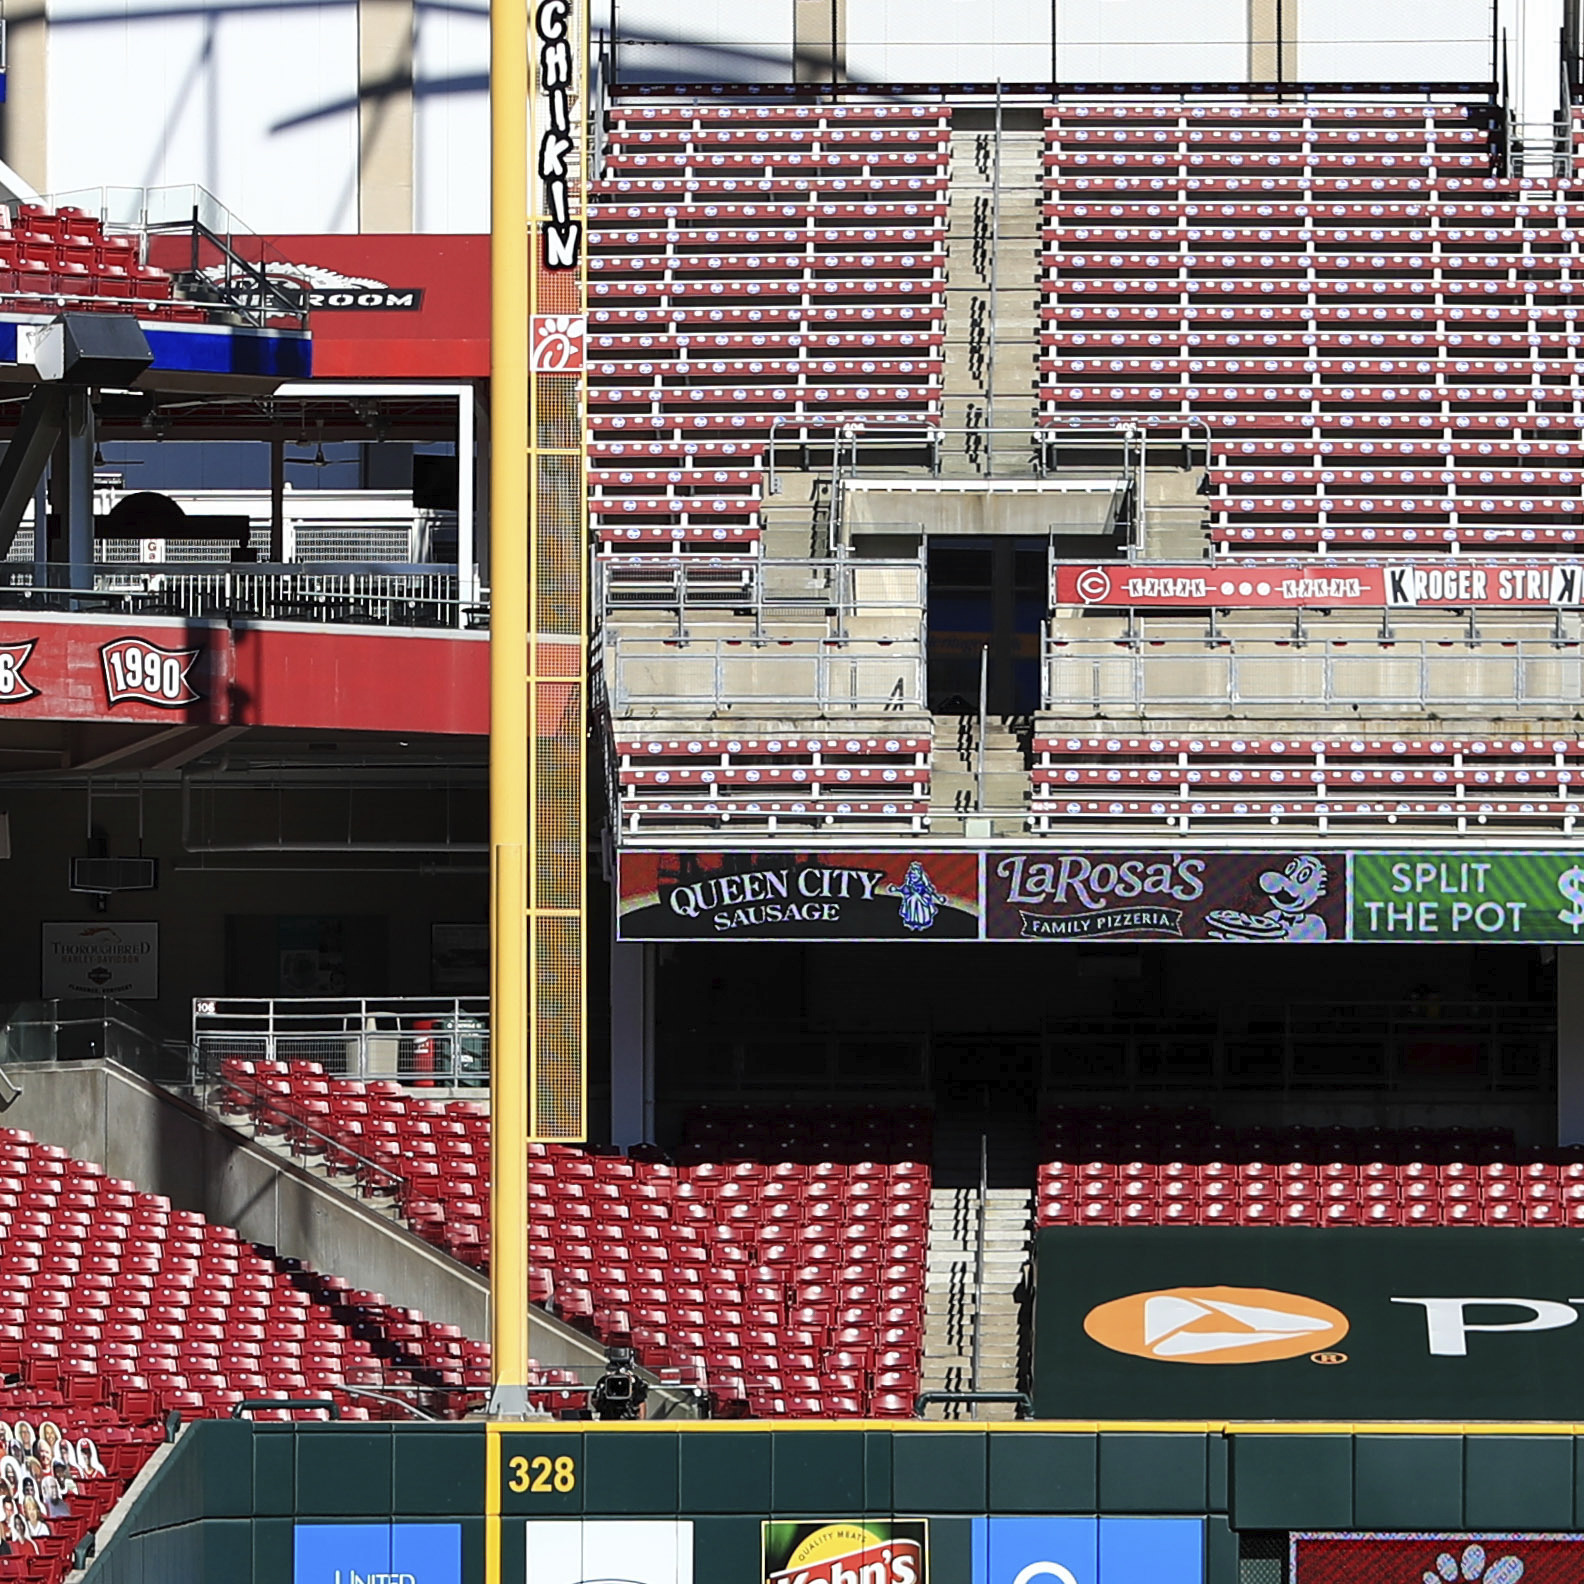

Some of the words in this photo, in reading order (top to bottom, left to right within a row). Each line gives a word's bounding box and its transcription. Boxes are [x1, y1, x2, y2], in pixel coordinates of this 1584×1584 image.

[541, 0, 578, 267] CHIKIN
[1389, 567, 1486, 604] KROGER
[109, 645, 180, 699] 1990
[670, 874, 791, 918] QUEEN
[797, 867, 884, 902] CITY
[1391, 863, 1491, 893] SPLIT
[713, 903, 841, 933] SAUSAGE
[1032, 916, 1091, 934] FAMILY
[1364, 900, 1441, 933] THE
[1448, 900, 1526, 933] POT
[52, 941, 151, 955] THOROUGHBRED
[507, 1455, 576, 1493] 328
[797, 1533, 834, 1562] QUALITY
[837, 1530, 867, 1544] MEATS
